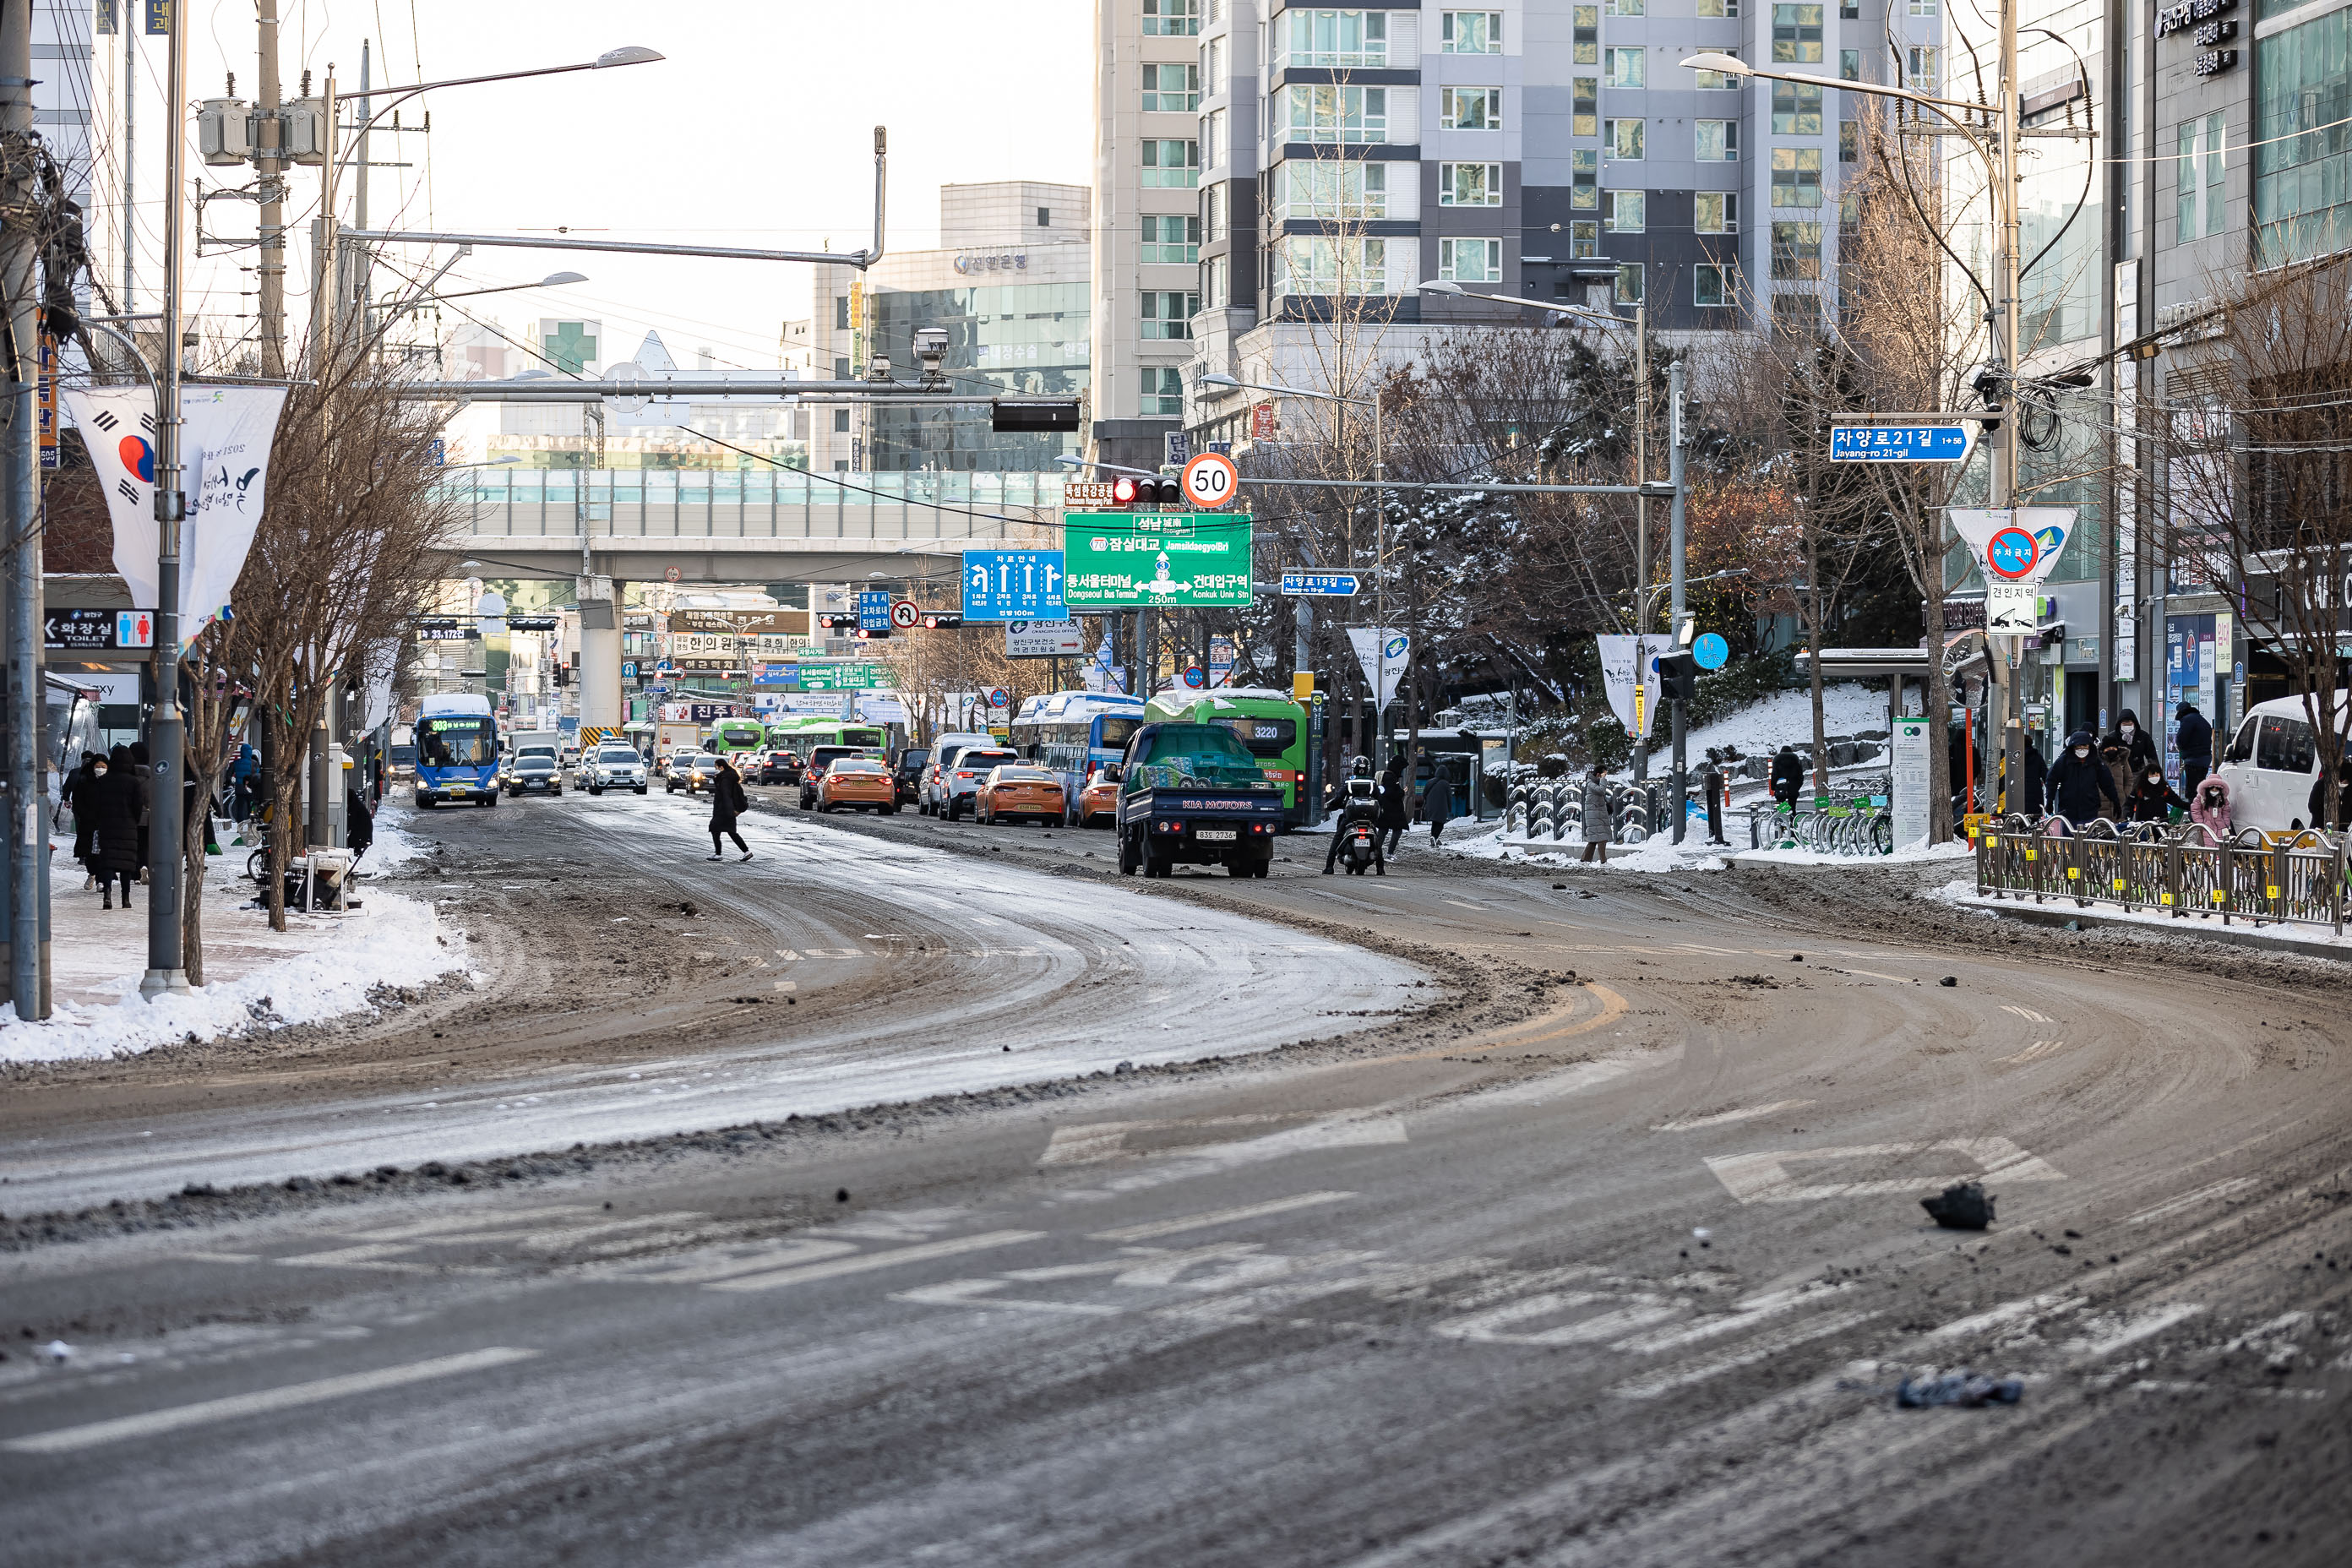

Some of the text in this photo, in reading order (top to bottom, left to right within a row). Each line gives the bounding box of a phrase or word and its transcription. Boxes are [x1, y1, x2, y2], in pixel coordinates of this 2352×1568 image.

[973, 253, 1026, 271] 신한은행
[1836, 429, 1932, 448] 자양로21길
[1835, 449, 1908, 459] Jayang-ro 21-gil
[1195, 470, 1226, 492] 50
[1065, 484, 1113, 498] 뚝섬한강공원
[1138, 517, 1162, 531] 성남
[1109, 537, 1161, 552] 잠실대교
[1995, 548, 2032, 557] 주차금지
[1066, 574, 1132, 589] 동서울터미널
[1193, 574, 1248, 589] 건대입구역
[1284, 577, 1337, 587] 자양로19길
[1067, 589, 1139, 599] Dongseoul Bus Terminal
[1193, 590, 1249, 598] Konkuk Univ Stn
[1993, 587, 2034, 598] 견인지역
[1148, 595, 1177, 604] 250m
[862, 606, 888, 615] 교차로내
[863, 618, 888, 628] 진입금지
[60, 623, 112, 635] 화장실
[432, 629, 465, 640] 33,172건
[433, 720, 448, 732] 303
[1255, 727, 1277, 738] 3220
[1183, 800, 1253, 810] KIA MOTORS
